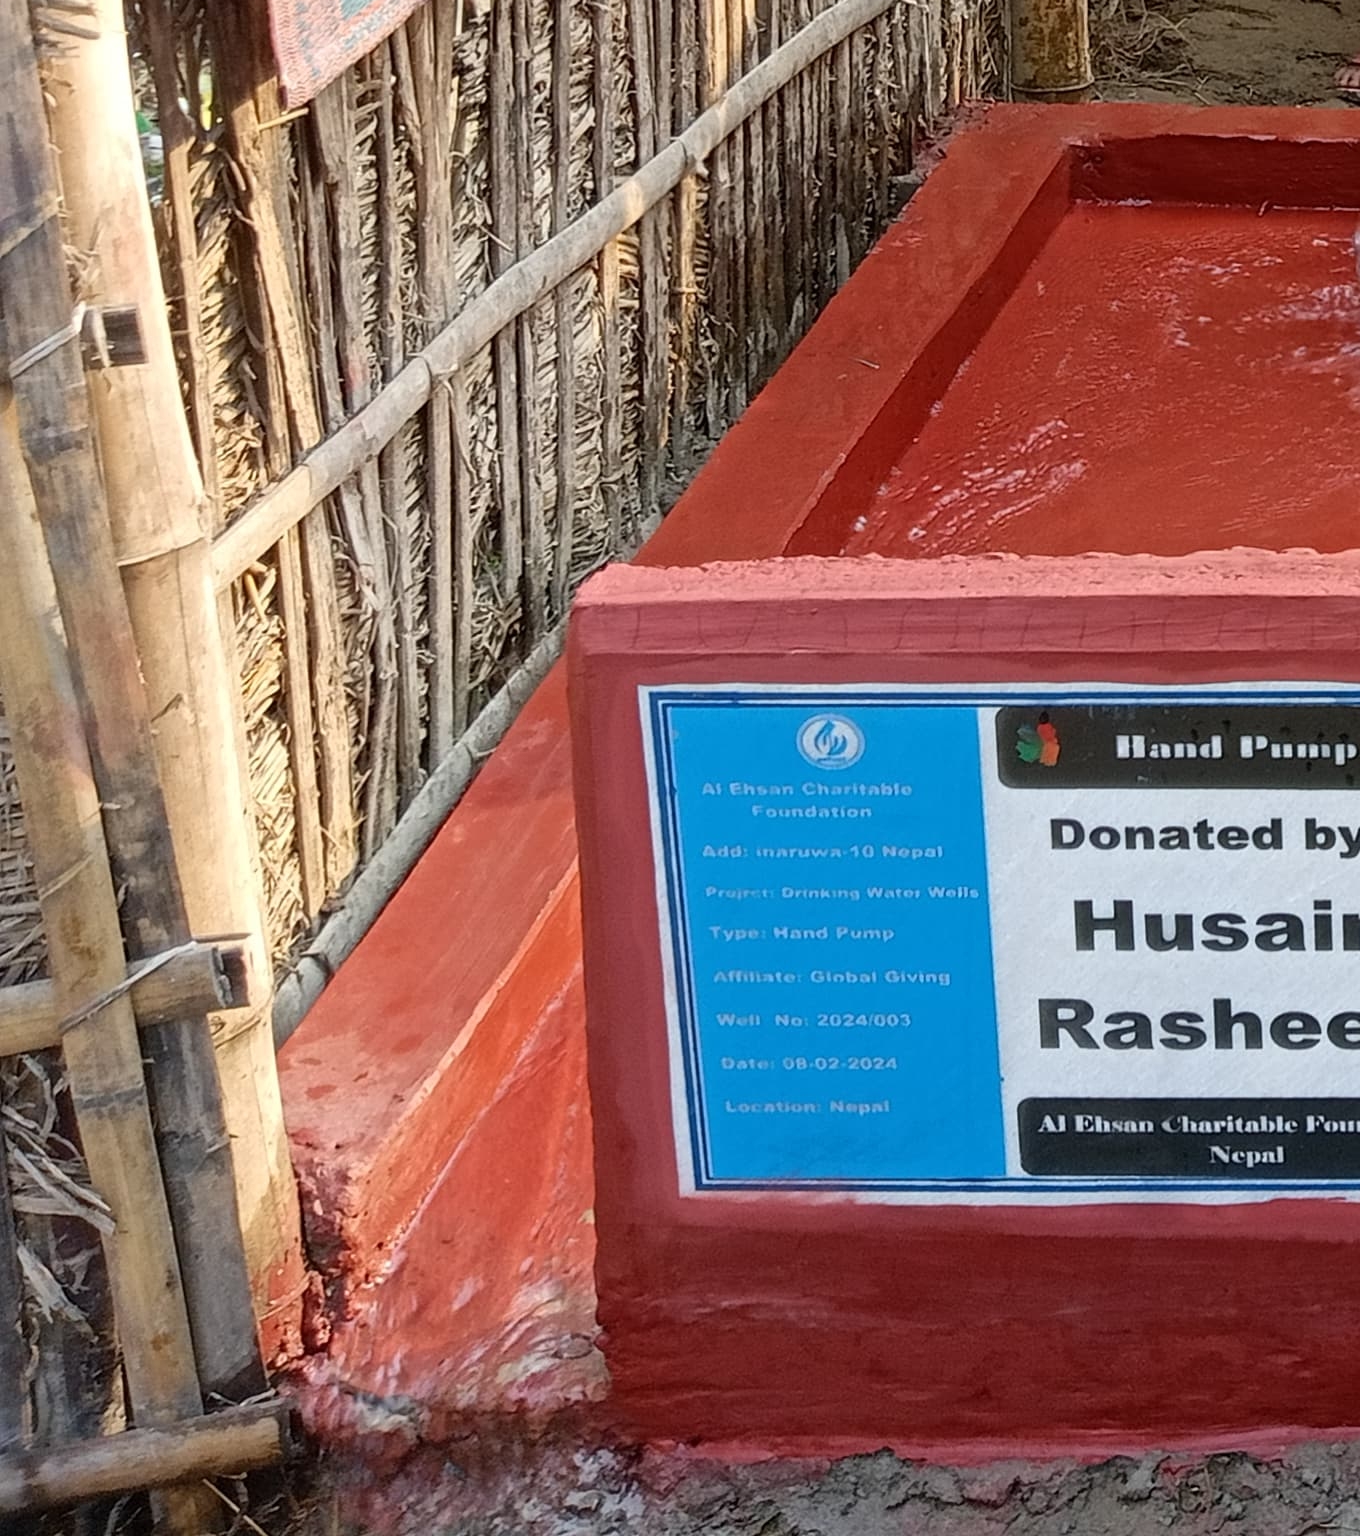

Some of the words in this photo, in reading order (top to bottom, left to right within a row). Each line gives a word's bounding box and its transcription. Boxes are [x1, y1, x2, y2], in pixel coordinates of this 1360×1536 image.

[1115, 733, 1224, 760] Hand
[1239, 734, 1359, 767] Pump
[701, 782, 723, 796] Al
[729, 782, 794, 796] Ehsan
[801, 782, 913, 797] Charitable
[751, 805, 873, 818] Foundation
[1049, 818, 1284, 851] Donated
[702, 845, 749, 859] Add:
[882, 845, 944, 860] Nepal
[781, 886, 861, 901] Drinking
[866, 886, 921, 900] Water
[927, 886, 980, 900] Wells
[709, 925, 767, 942] Type:
[773, 926, 829, 940] Hand
[835, 926, 896, 942] Pump
[713, 970, 802, 984] Affiliate:
[809, 970, 878, 984] Global
[884, 970, 951, 986] Giving
[716, 1013, 761, 1027] Well
[774, 1013, 809, 1027] No:
[721, 1056, 775, 1070] Date:
[725, 1099, 822, 1114] Location:
[829, 1099, 890, 1116] Nepal
[1037, 1114, 1067, 1134] Al
[1074, 1114, 1155, 1134] Ehsan
[1161, 1114, 1299, 1134] Charitable
[1207, 1144, 1286, 1169] Nepal
